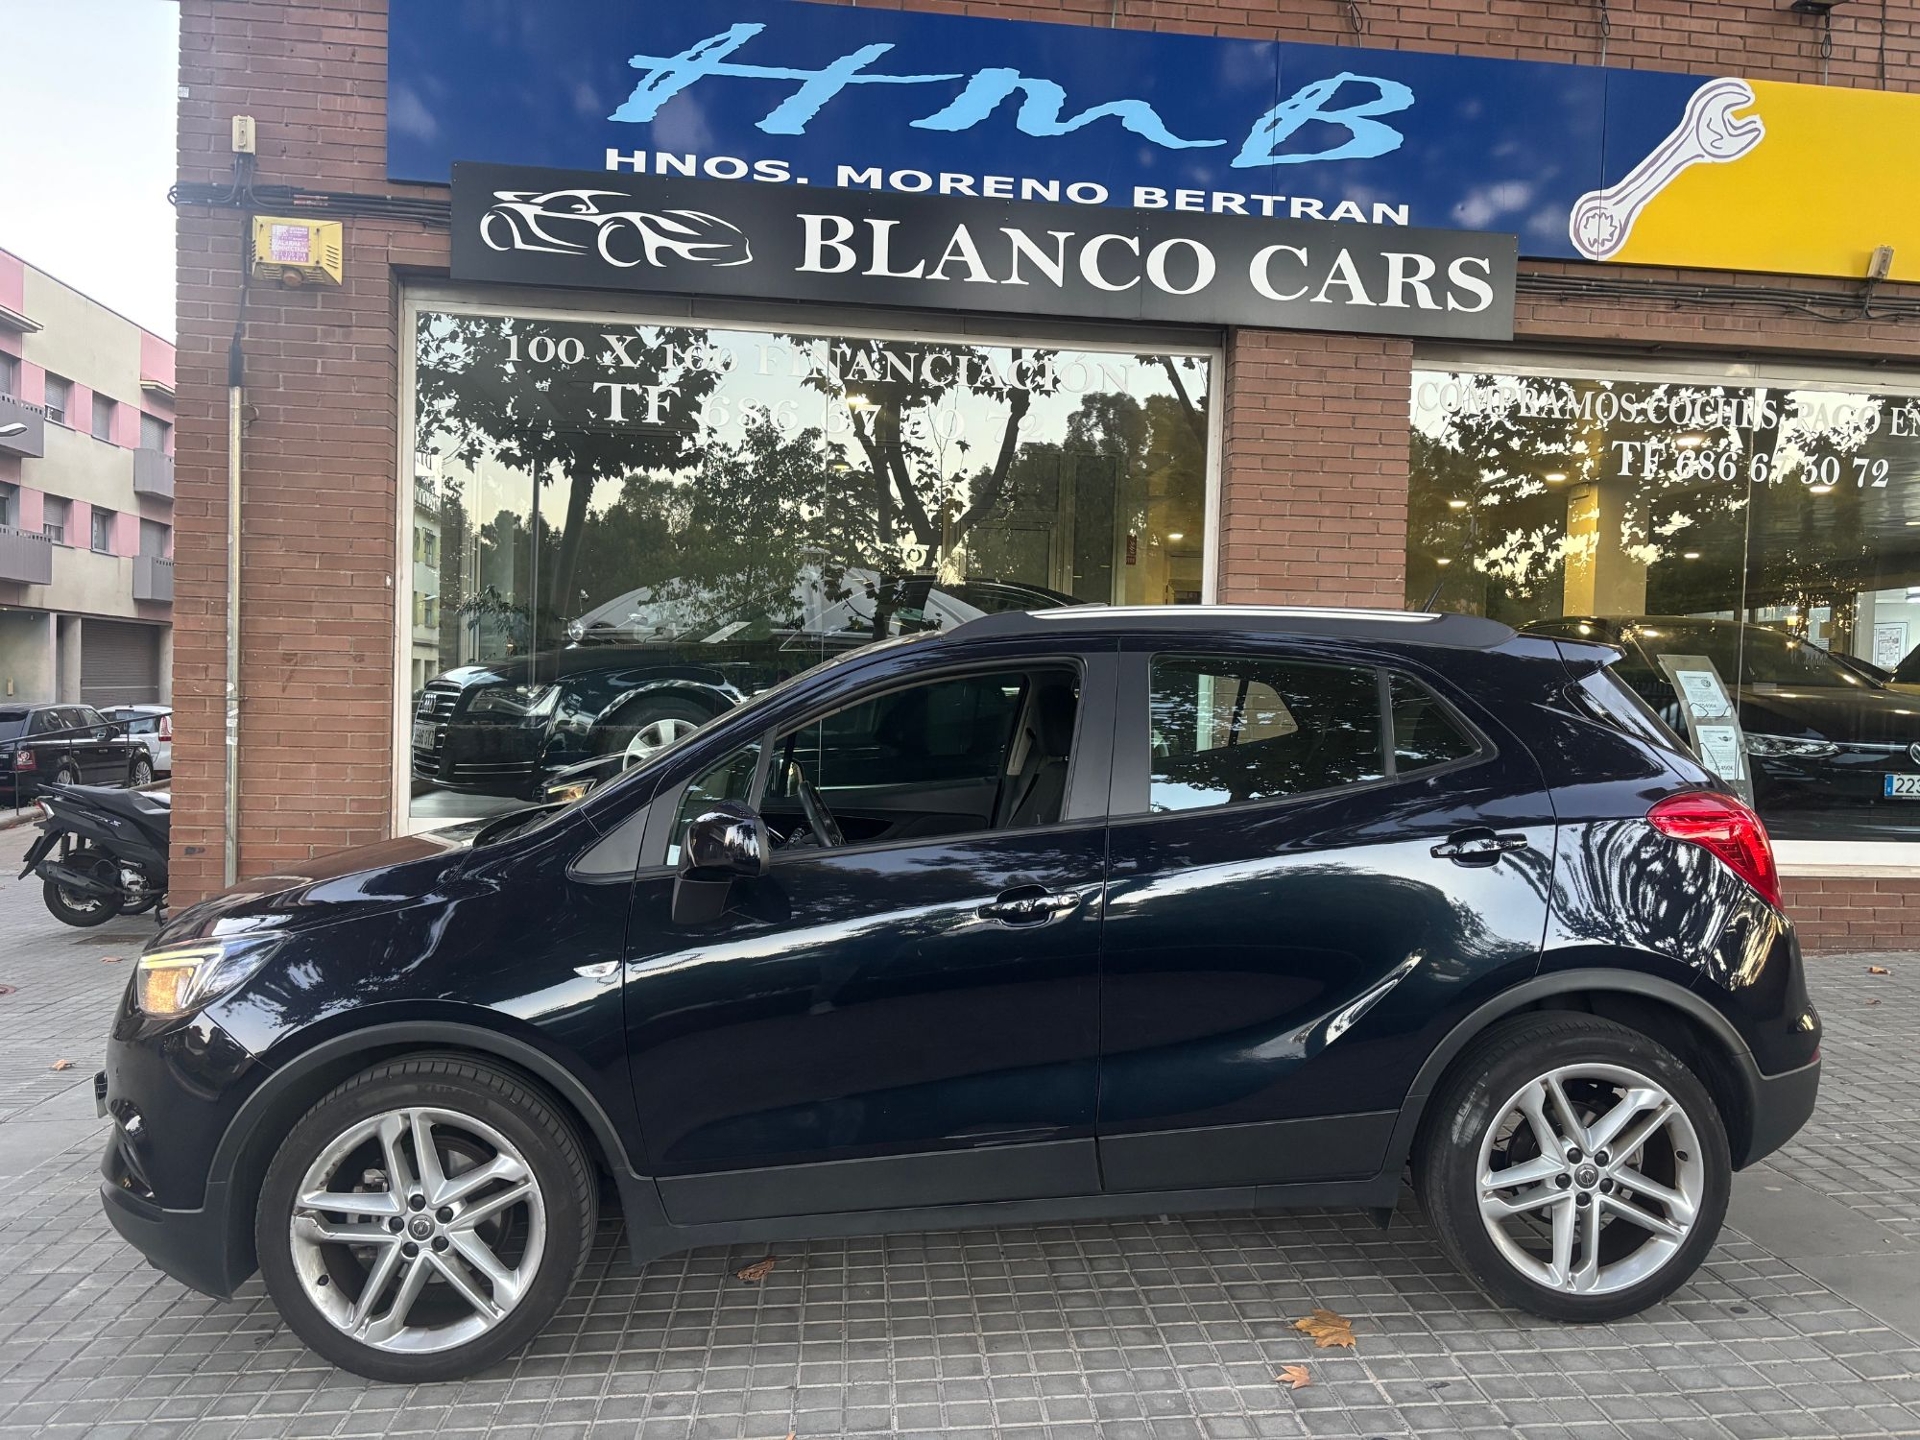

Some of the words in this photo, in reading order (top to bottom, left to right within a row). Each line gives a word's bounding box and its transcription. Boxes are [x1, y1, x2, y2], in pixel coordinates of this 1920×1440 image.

[606, 148, 809, 185] HNOS.
[836, 165, 1109, 204] MORENO
[1133, 186, 1409, 226] BERTRAN
[795, 213, 1217, 296] BLANCO
[1249, 244, 1494, 313] CARS
[504, 334, 584, 365] 100
[600, 334, 640, 368] X
[661, 343, 738, 374] 100
[592, 381, 681, 425] TF
[701, 395, 800, 432] 686
[820, 403, 882, 437] 67
[984, 408, 1045, 443] 72
[1417, 381, 1638, 423] COMPRAMOS
[1795, 402, 1881, 435] PAGO
[1676, 448, 1738, 482] 686
[1750, 452, 1794, 485] 67
[1800, 453, 1841, 486] 50
[1852, 456, 1890, 488] 72
